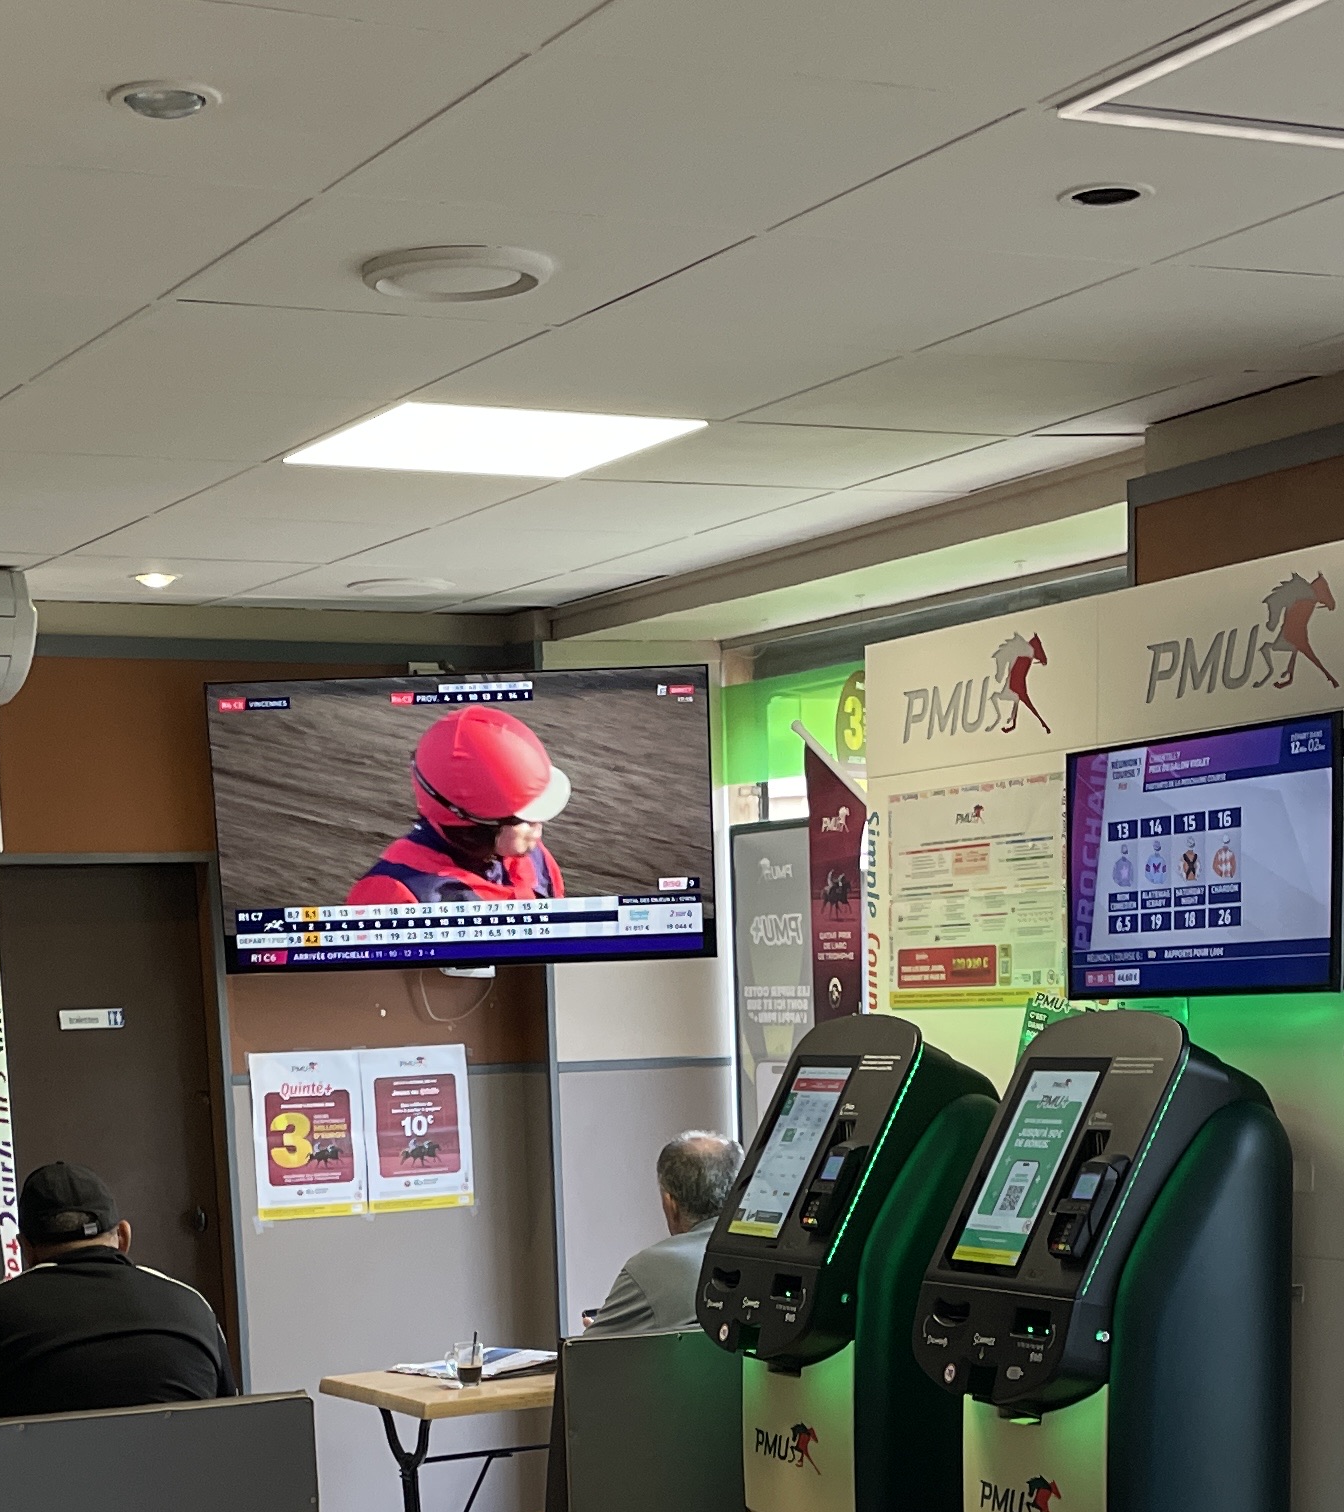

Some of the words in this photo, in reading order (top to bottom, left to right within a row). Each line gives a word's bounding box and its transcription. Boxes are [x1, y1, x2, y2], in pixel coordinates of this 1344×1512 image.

[1144, 624, 1259, 704] PMU
[903, 676, 990, 744] PMU
[956, 811, 976, 825] PMU
[1117, 822, 1130, 838] 13
[1149, 818, 1163, 836] 14
[1182, 814, 1196, 832] 15
[1217, 810, 1232, 828] 16
[251, 912, 263, 921] C7
[1150, 914, 1162, 929] 19
[1184, 912, 1196, 927] 18
[1218, 909, 1232, 925] 26
[250, 954, 262, 963] R1
[263, 954, 277, 962] C6
[327, 950, 370, 960] OFFICIELLE
[281, 1082, 333, 1100] Quinté+
[401, 1114, 434, 1137] 10€
[269, 1112, 313, 1169] 3
[756, 1428, 790, 1462] PMU
